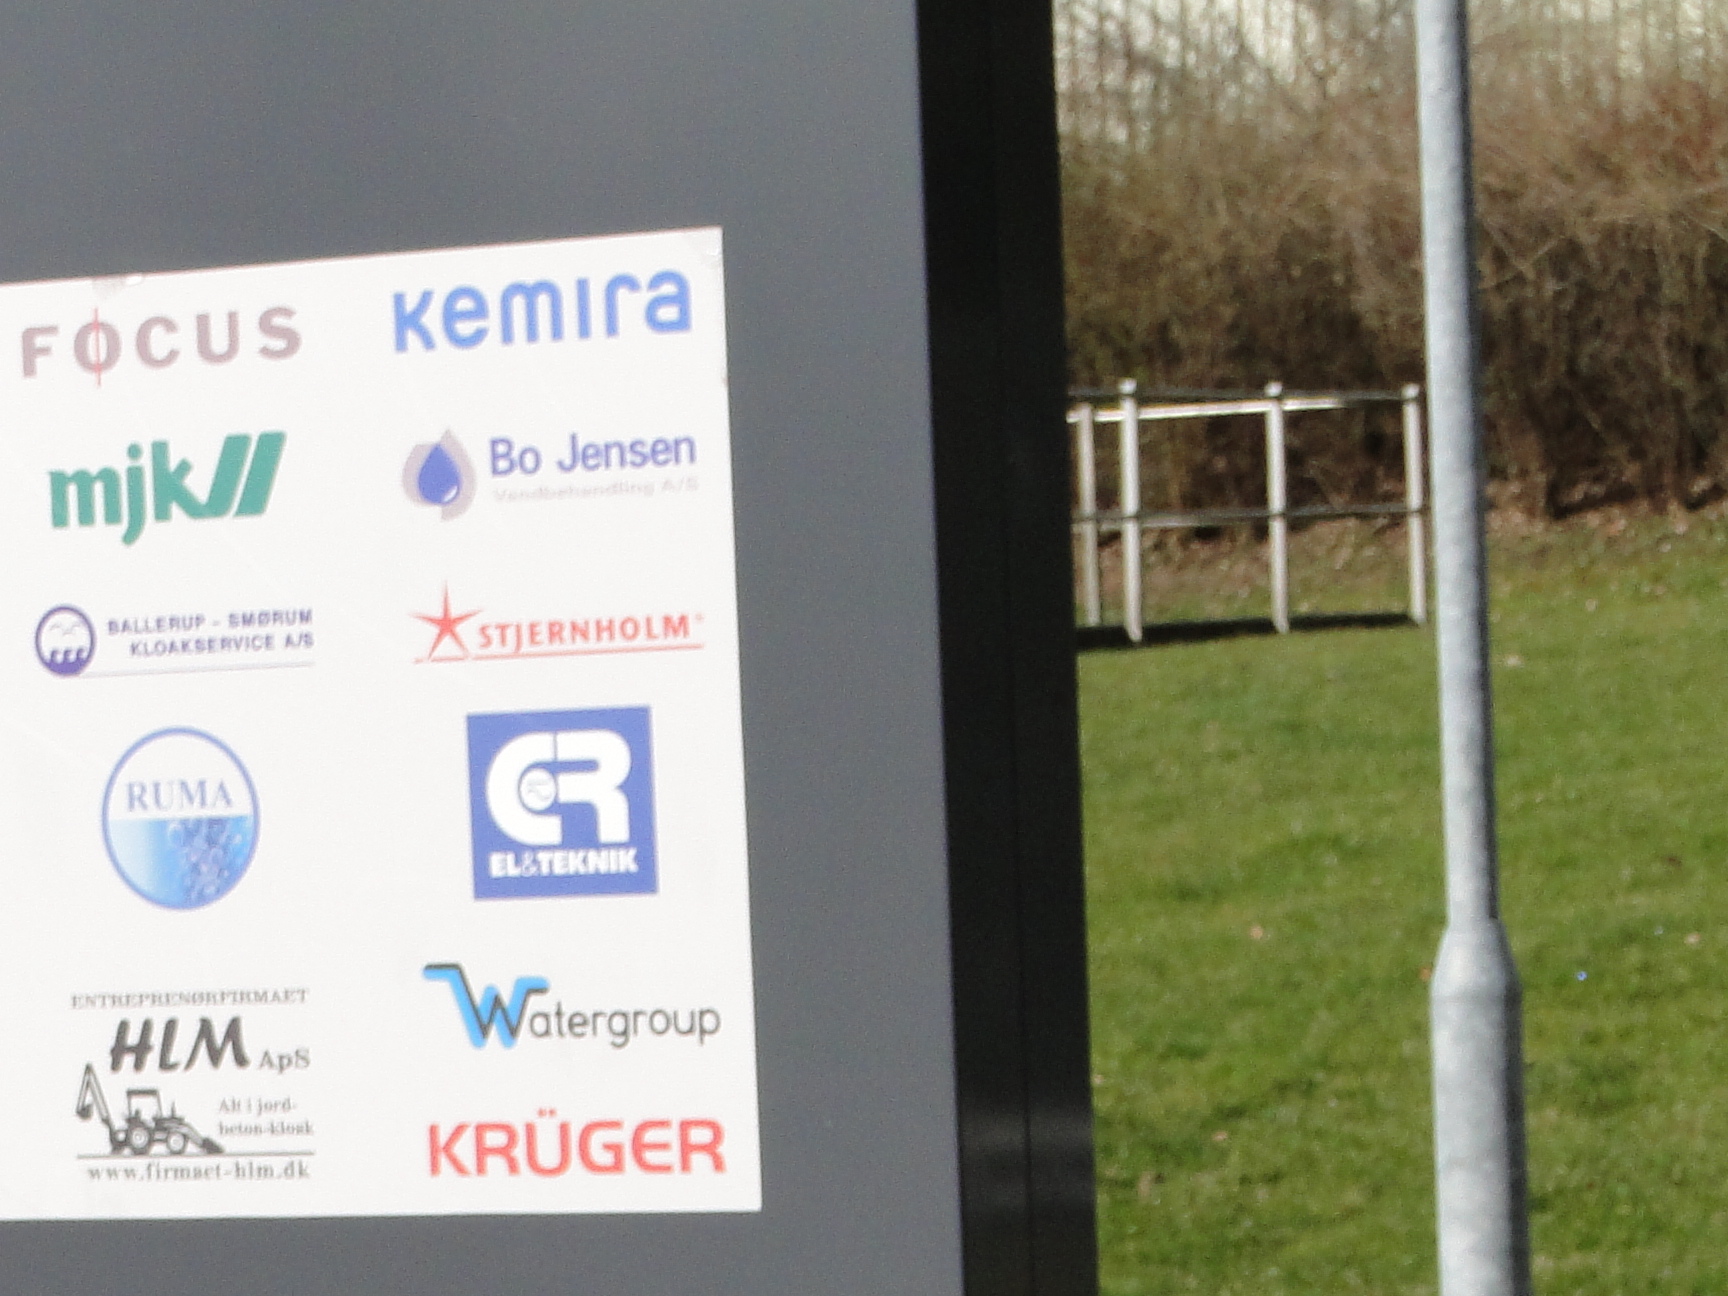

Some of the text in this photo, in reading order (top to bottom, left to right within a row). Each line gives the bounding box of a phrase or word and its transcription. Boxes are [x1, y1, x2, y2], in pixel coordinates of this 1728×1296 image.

[489, 433, 696, 477] Bo Jensen
[108, 612, 206, 635] BALLERUP
[129, 631, 314, 657] KLOAKSERVICE A/S
[478, 613, 692, 654] STJERNHOLM
[126, 779, 234, 812] RUMA
[423, 963, 721, 1049] Watergroup
[109, 1015, 312, 1074] HLM ApS
[428, 1108, 726, 1177] KRÜGER
